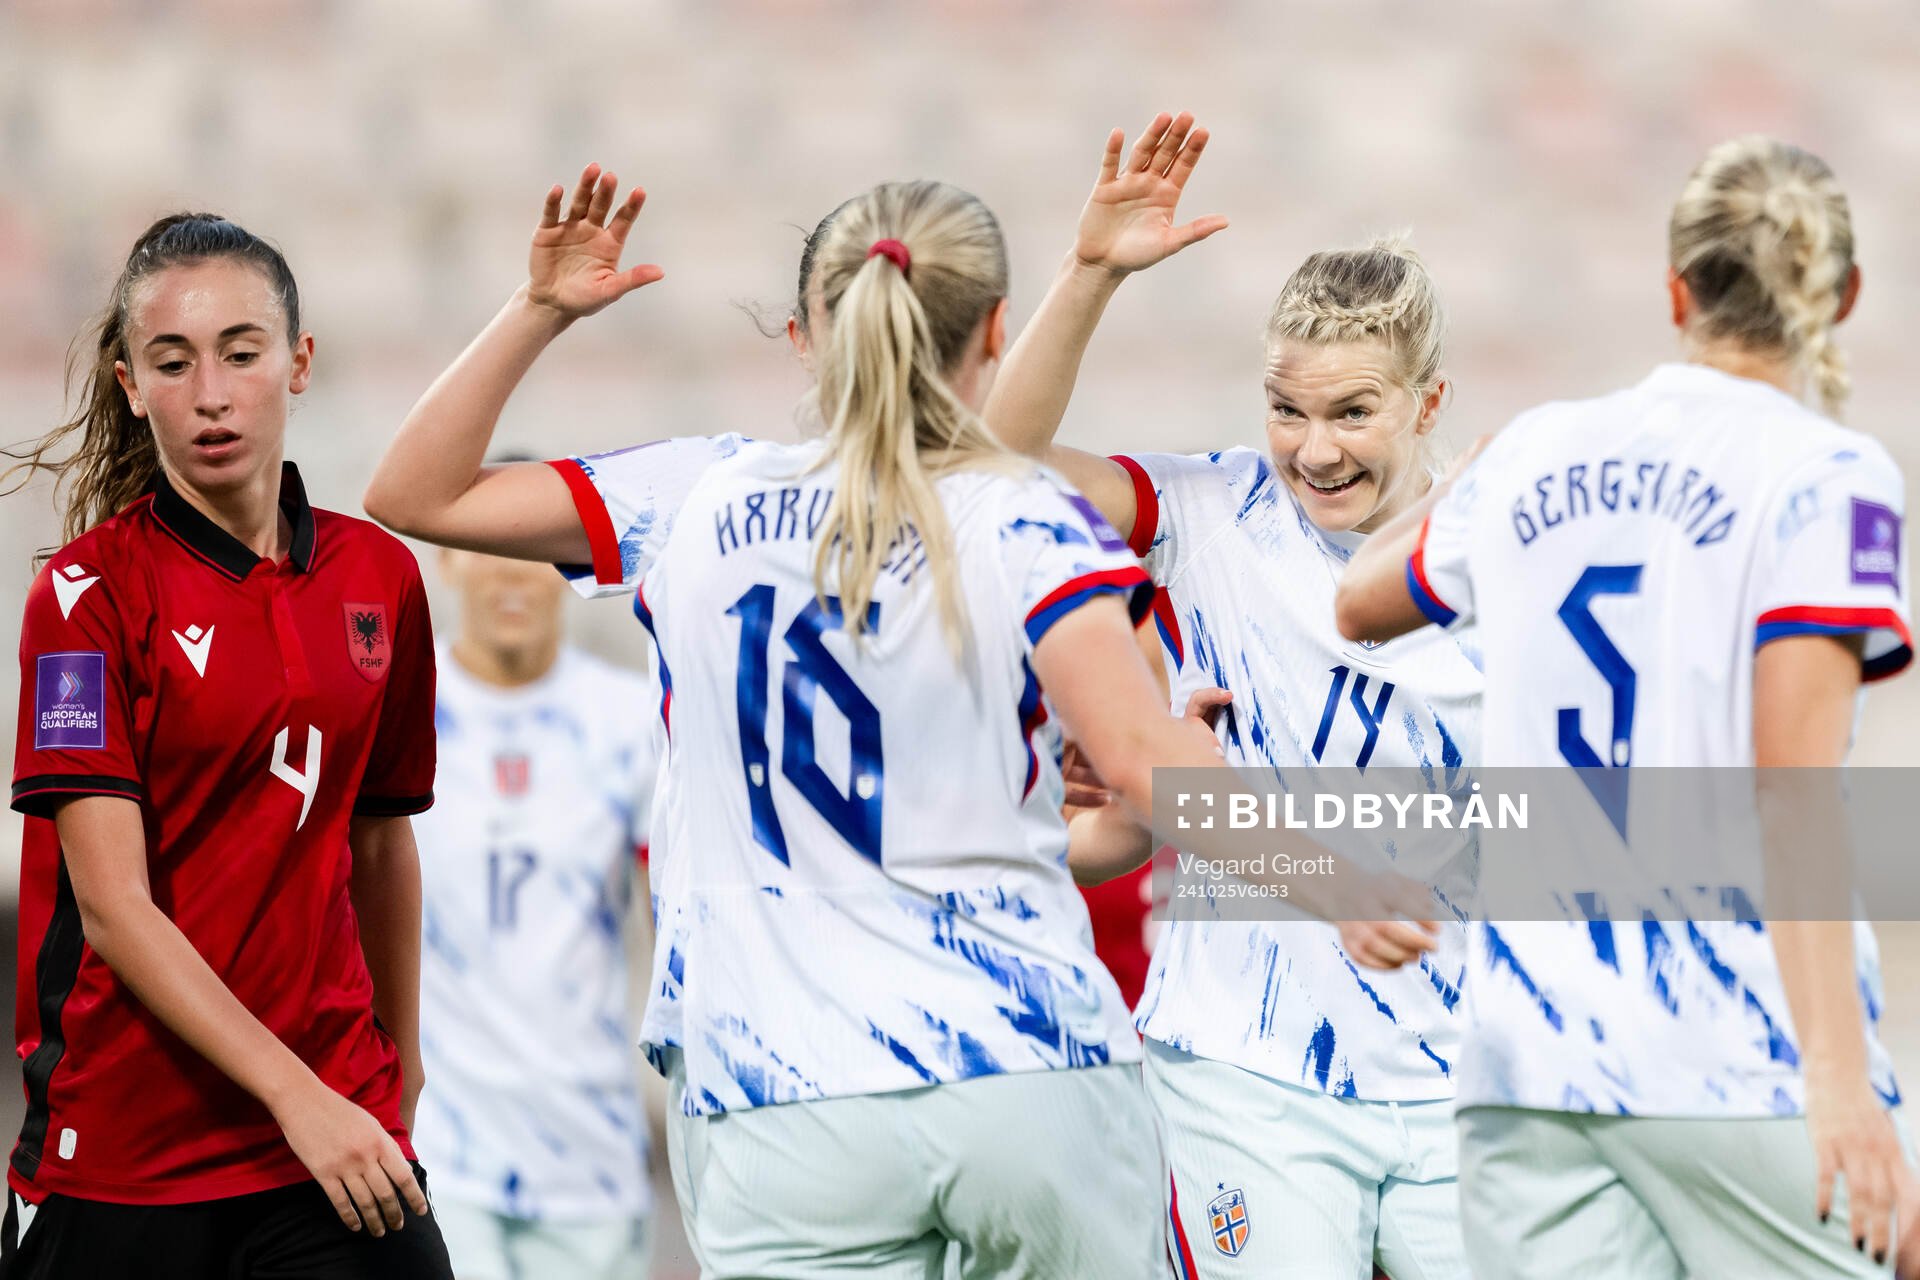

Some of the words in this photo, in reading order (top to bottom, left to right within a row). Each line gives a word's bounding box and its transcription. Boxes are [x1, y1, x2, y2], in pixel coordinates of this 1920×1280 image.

[360, 657, 384, 669] FSHF
[1557, 564, 1645, 844] 5
[40, 719, 98, 729] QUALIFIERS
[42, 710, 97, 720] EUROPEAN
[725, 584, 884, 869] 16
[1311, 665, 1396, 777] 14
[269, 723, 323, 833] 4
[486, 849, 539, 933] 17
